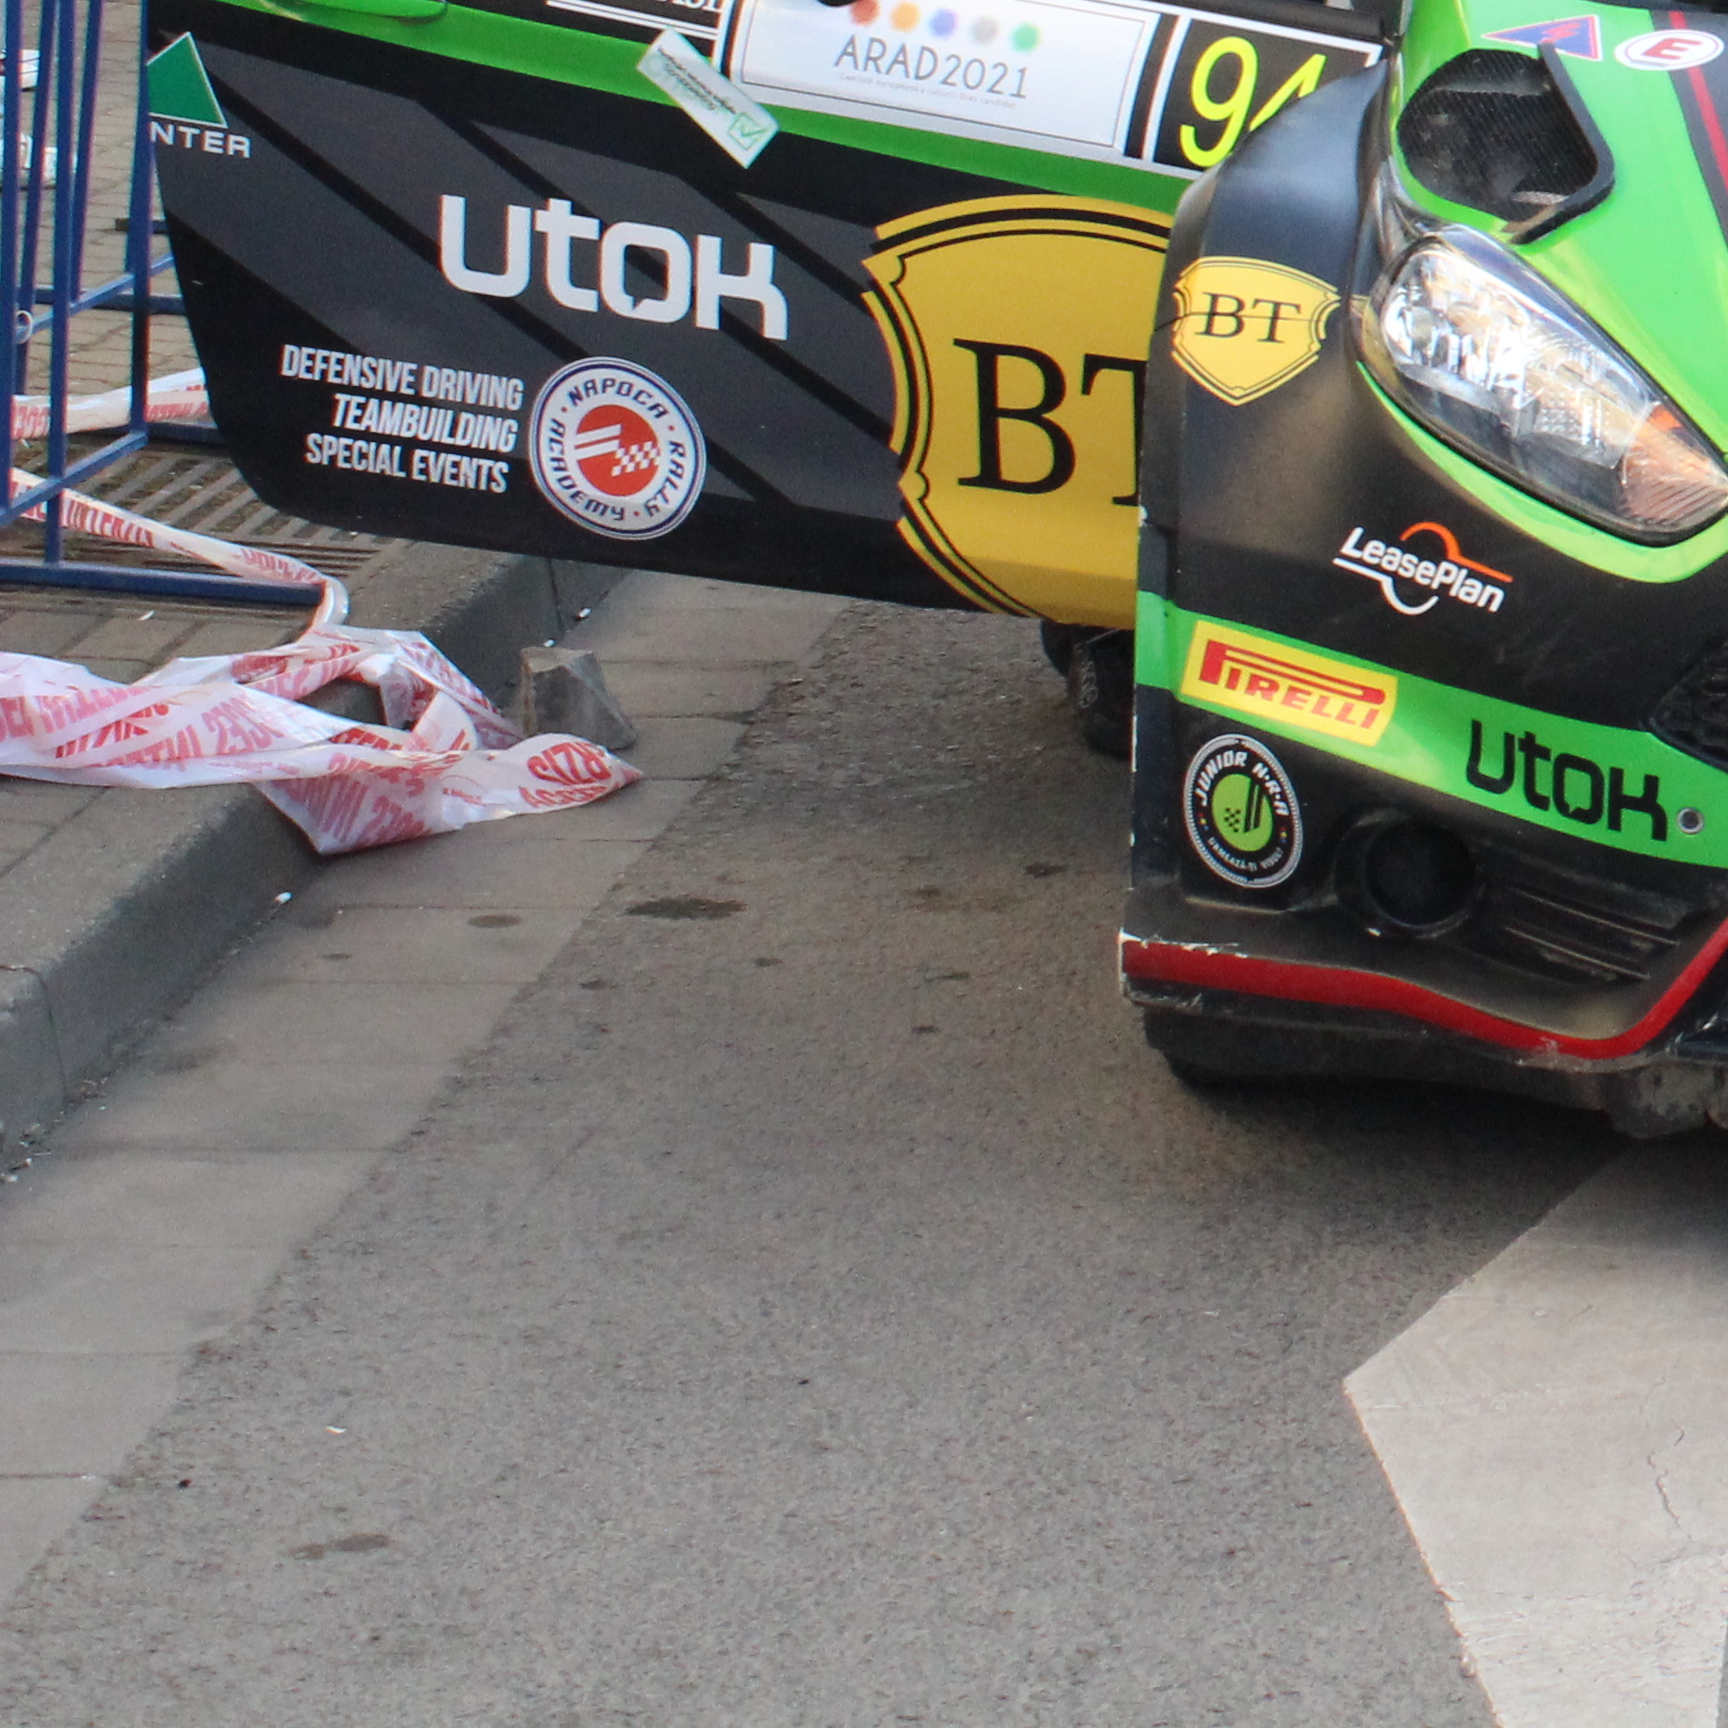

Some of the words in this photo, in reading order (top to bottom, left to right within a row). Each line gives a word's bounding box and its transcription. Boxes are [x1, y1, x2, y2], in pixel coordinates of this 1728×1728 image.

[834, 34, 1028, 99] ARAD2021
[1641, 35, 1703, 63] E
[148, 121, 251, 159] NTER
[1195, 291, 1303, 345] BT
[281, 343, 419, 399] DEFENSIVE
[421, 365, 525, 411] DRIVING
[568, 377, 671, 421] NAPOCA
[331, 392, 520, 453] TEAMBUILDING
[953, 336, 1148, 508] BT
[305, 430, 408, 479] SPECIAL
[411, 452, 510, 495] EVENTS
[550, 415, 628, 522] ACADEMY
[643, 439, 685, 519] RALLY
[1341, 527, 1506, 614] LeasePlan
[1198, 638, 1388, 732] PIRELLI
[1194, 749, 1248, 808] JUNIOR
